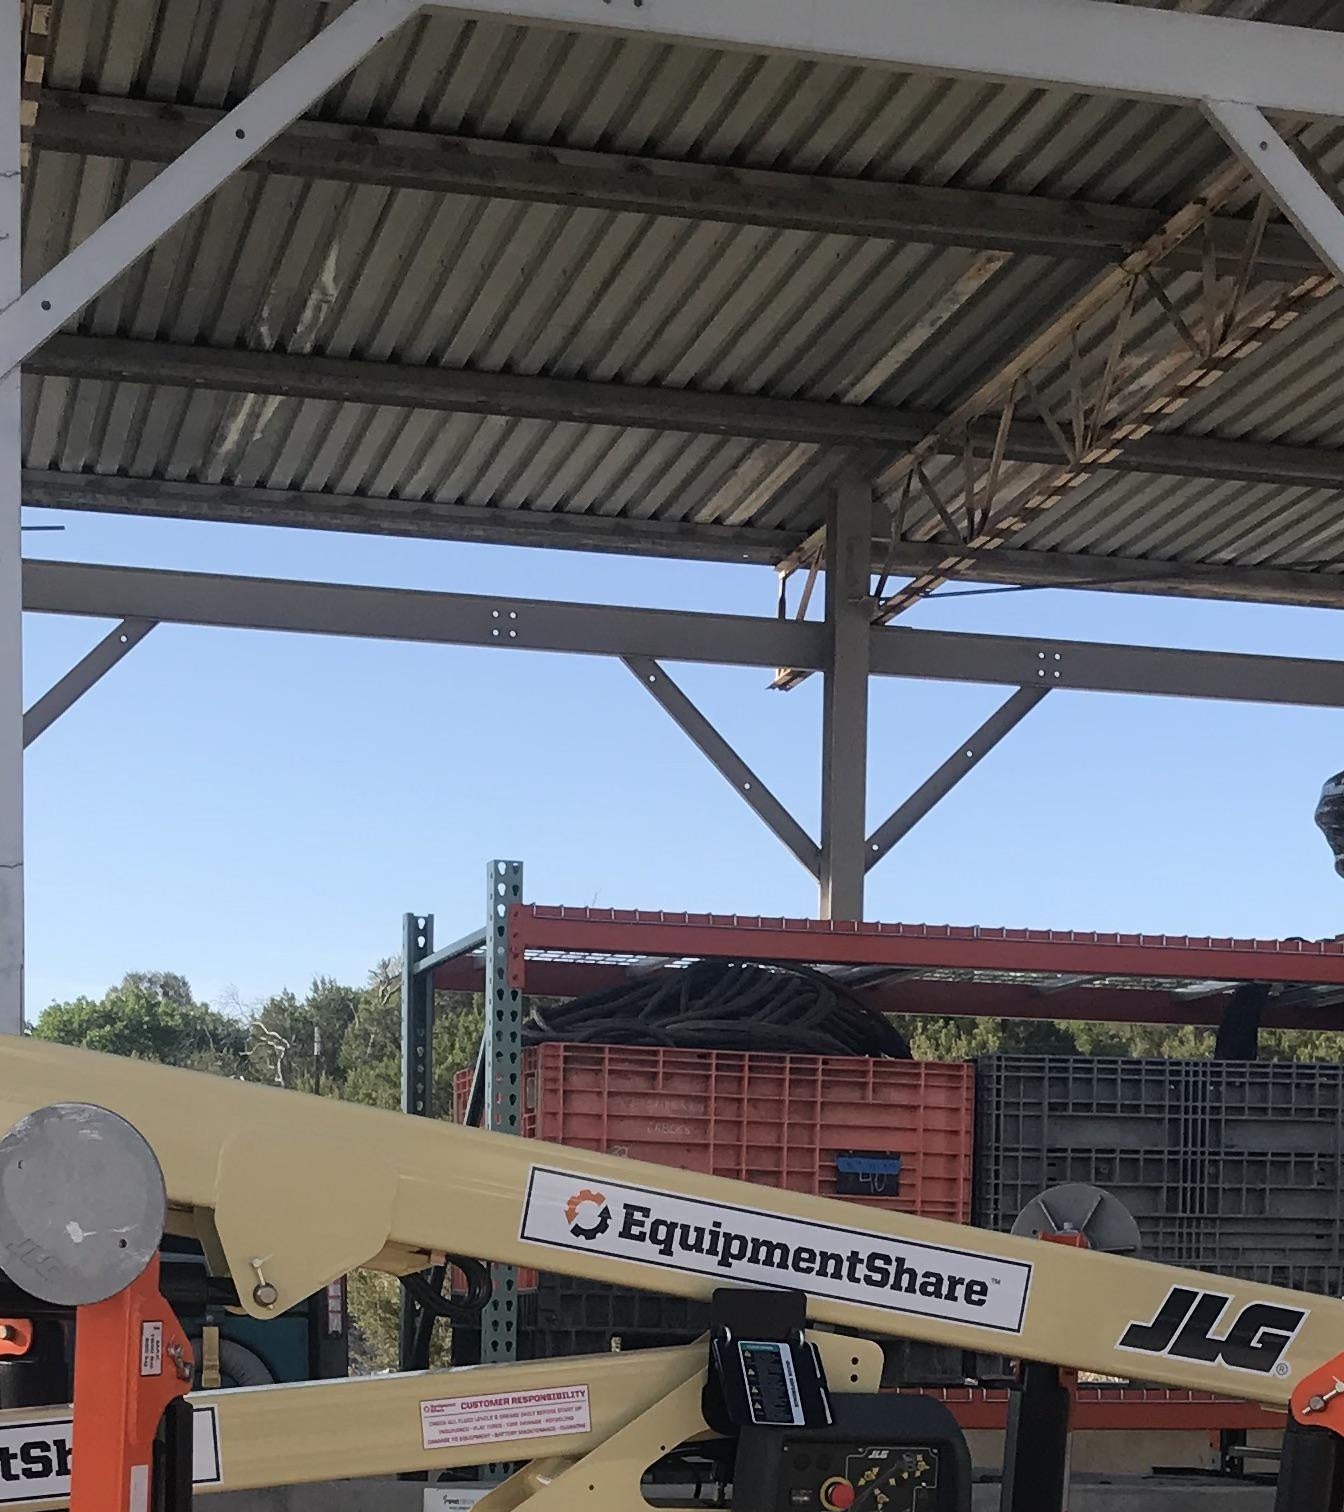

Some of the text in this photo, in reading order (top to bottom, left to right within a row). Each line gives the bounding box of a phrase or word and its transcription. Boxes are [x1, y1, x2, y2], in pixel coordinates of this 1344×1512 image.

[618, 1203, 989, 1308] EquipmentShare
[1118, 1287, 1307, 1374] JLG
[460, 1390, 586, 1410] CUSTOMER RESPONSIBILITY
